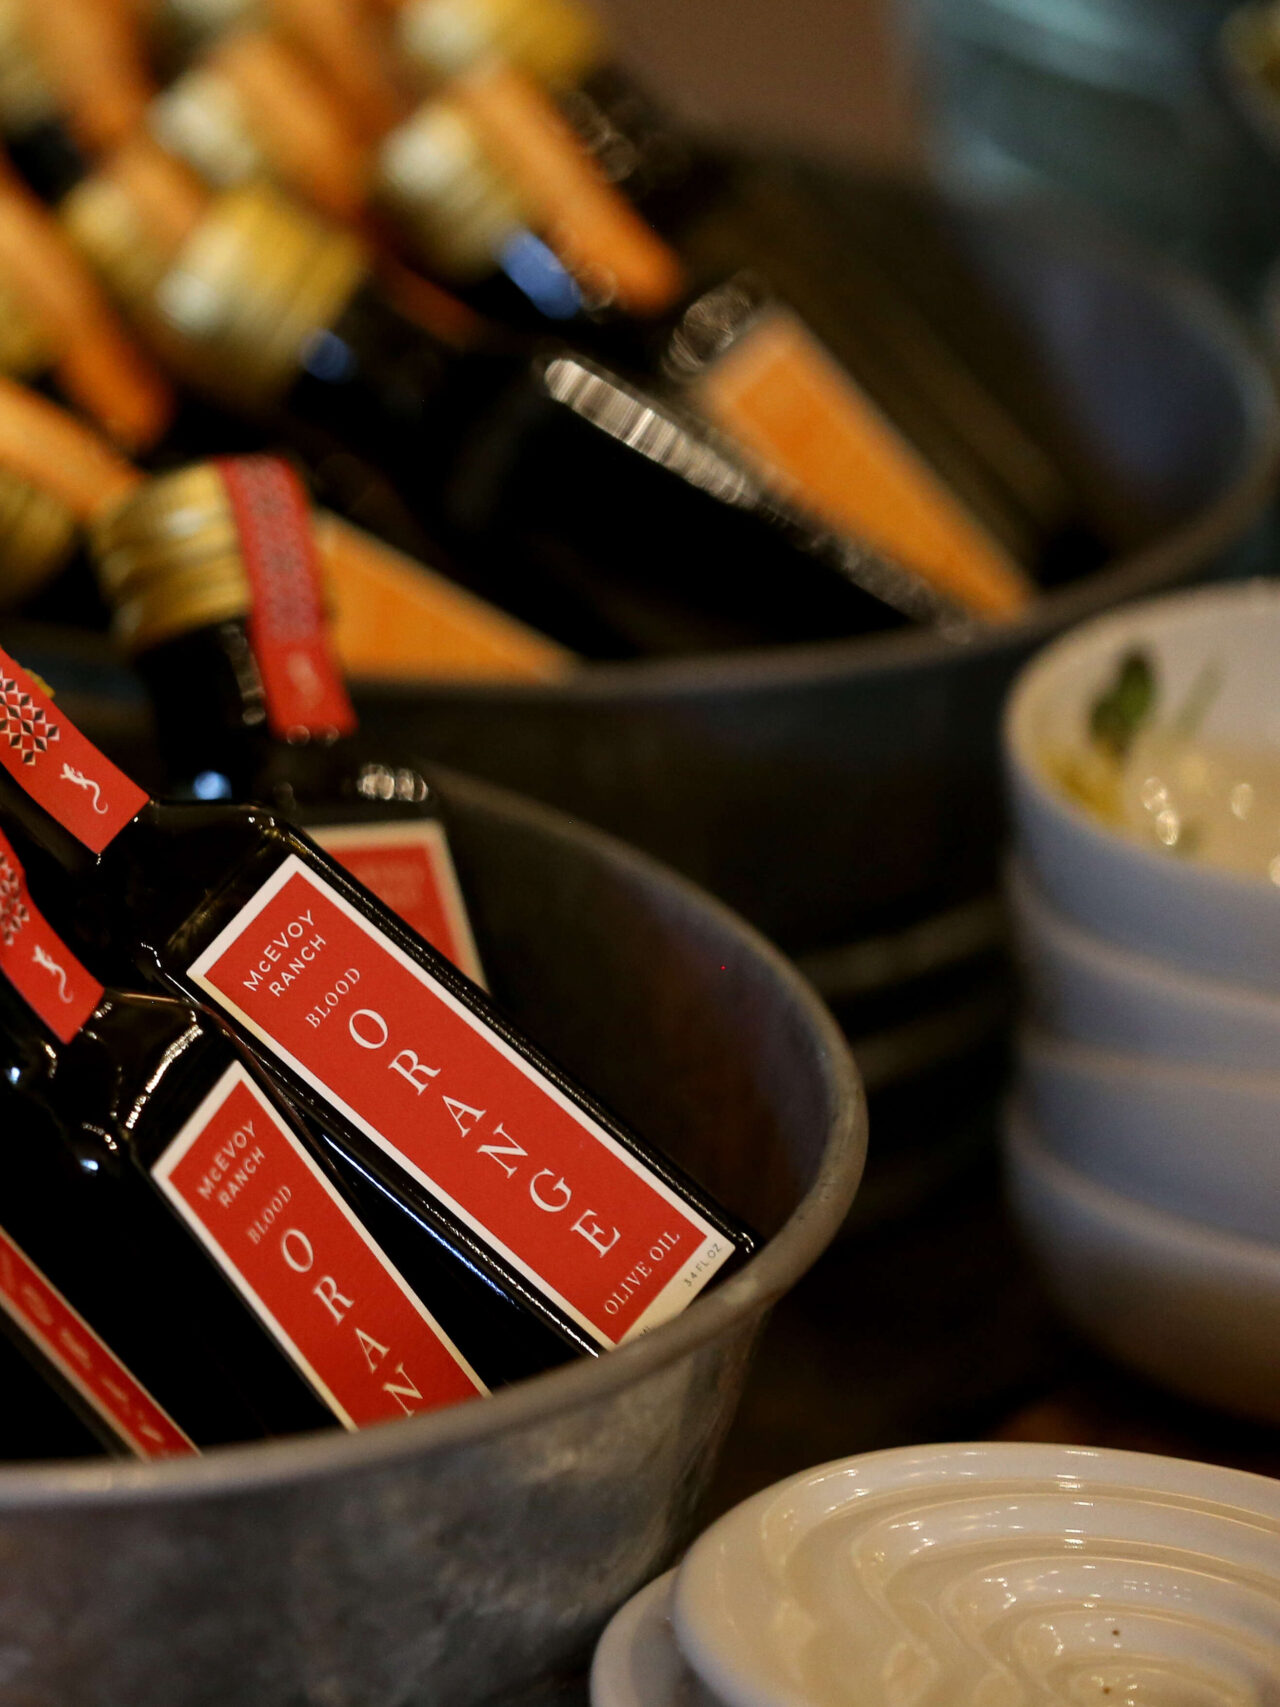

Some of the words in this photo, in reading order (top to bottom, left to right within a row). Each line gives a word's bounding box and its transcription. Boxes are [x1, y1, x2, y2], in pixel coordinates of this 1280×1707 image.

[243, 909, 315, 992] McEVOY
[268, 934, 327, 997] RANCH
[305, 968, 361, 1029] BLOOD
[197, 1120, 256, 1200] McEVOY
[348, 1008, 621, 1258] ORANGE
[218, 1146, 266, 1208] RANCH
[246, 1185, 292, 1245] BLOOD
[604, 1261, 653, 1315] OLIVE
[649, 1232, 681, 1262] OIL
[683, 1271, 698, 1288] 34
[707, 1242, 723, 1259] OZ
